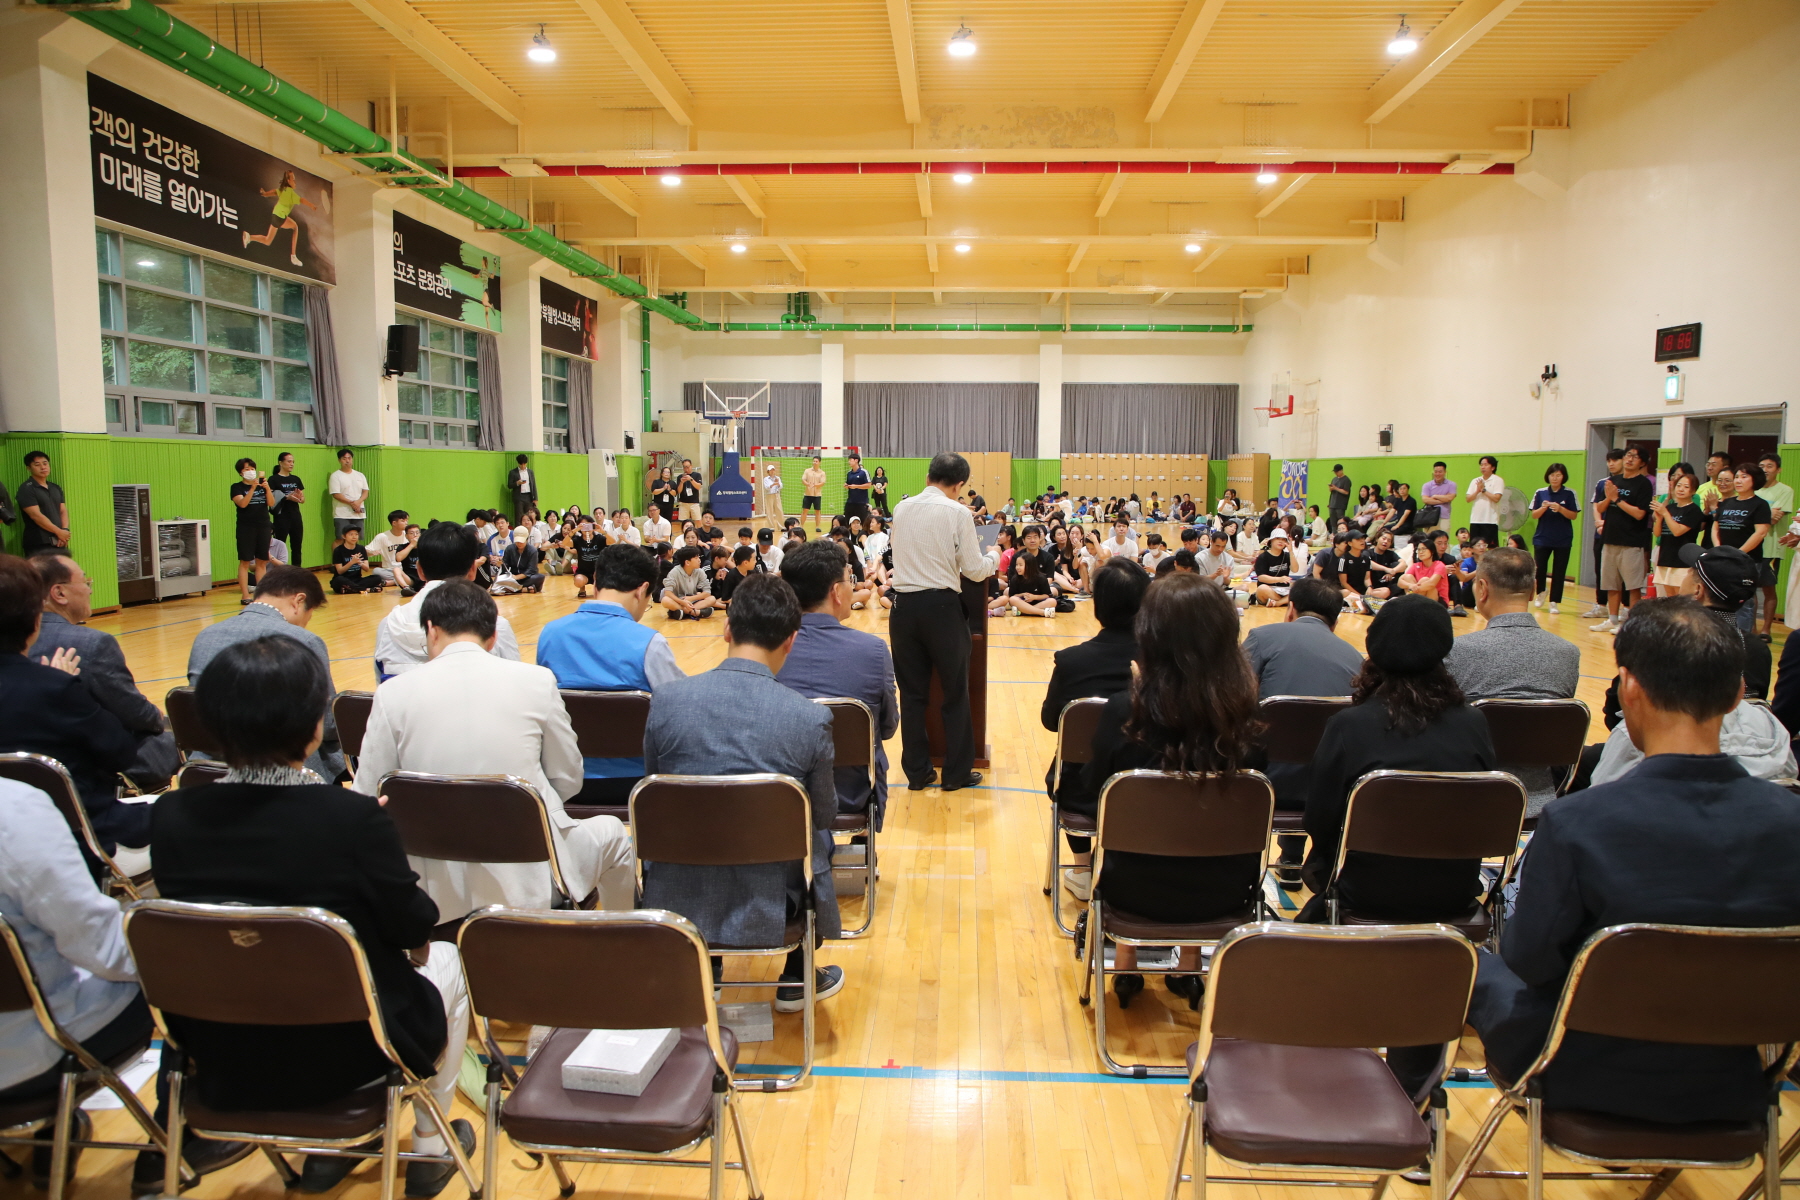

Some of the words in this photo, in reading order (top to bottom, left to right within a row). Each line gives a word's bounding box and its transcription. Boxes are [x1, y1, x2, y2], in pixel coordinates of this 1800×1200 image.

[90, 106, 136, 155] 객의
[142, 127, 200, 179] 건강한
[100, 152, 163, 205] 미래를
[168, 178, 239, 230] 열어가는
[418, 268, 452, 299] 문화공간
[541, 304, 581, 332] 북웰빙스포츠센터
[1616, 488, 1631, 497] PSC
[1722, 509, 1749, 517] WPSC
